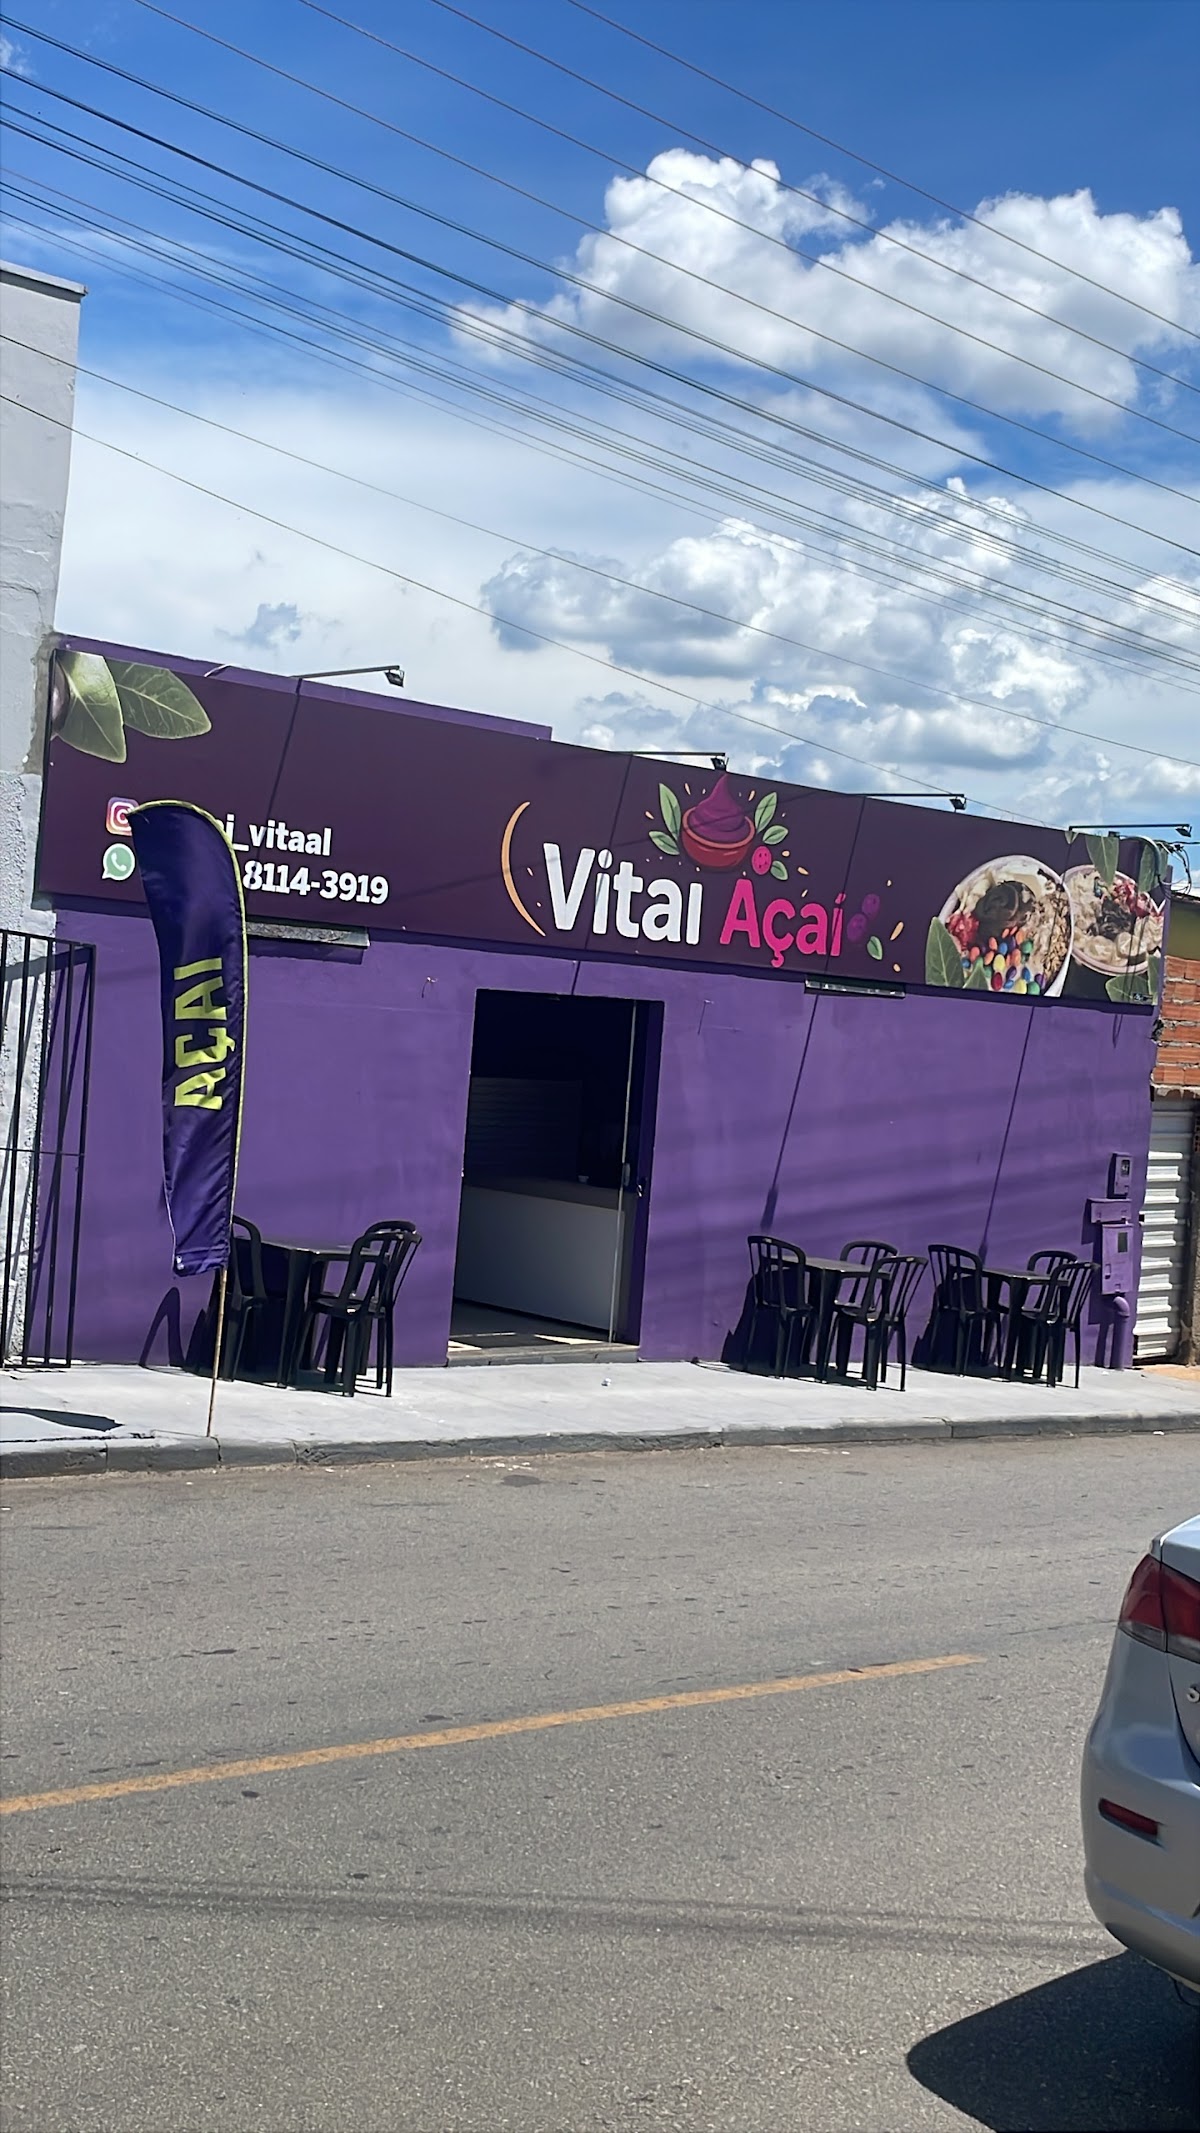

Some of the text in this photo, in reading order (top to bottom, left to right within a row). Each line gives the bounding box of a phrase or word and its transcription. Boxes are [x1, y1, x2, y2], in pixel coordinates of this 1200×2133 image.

[242, 860, 389, 905] 8114-3919
[543, 842, 847, 968] Vital Açaí
[174, 957, 235, 1110] AÇAI
